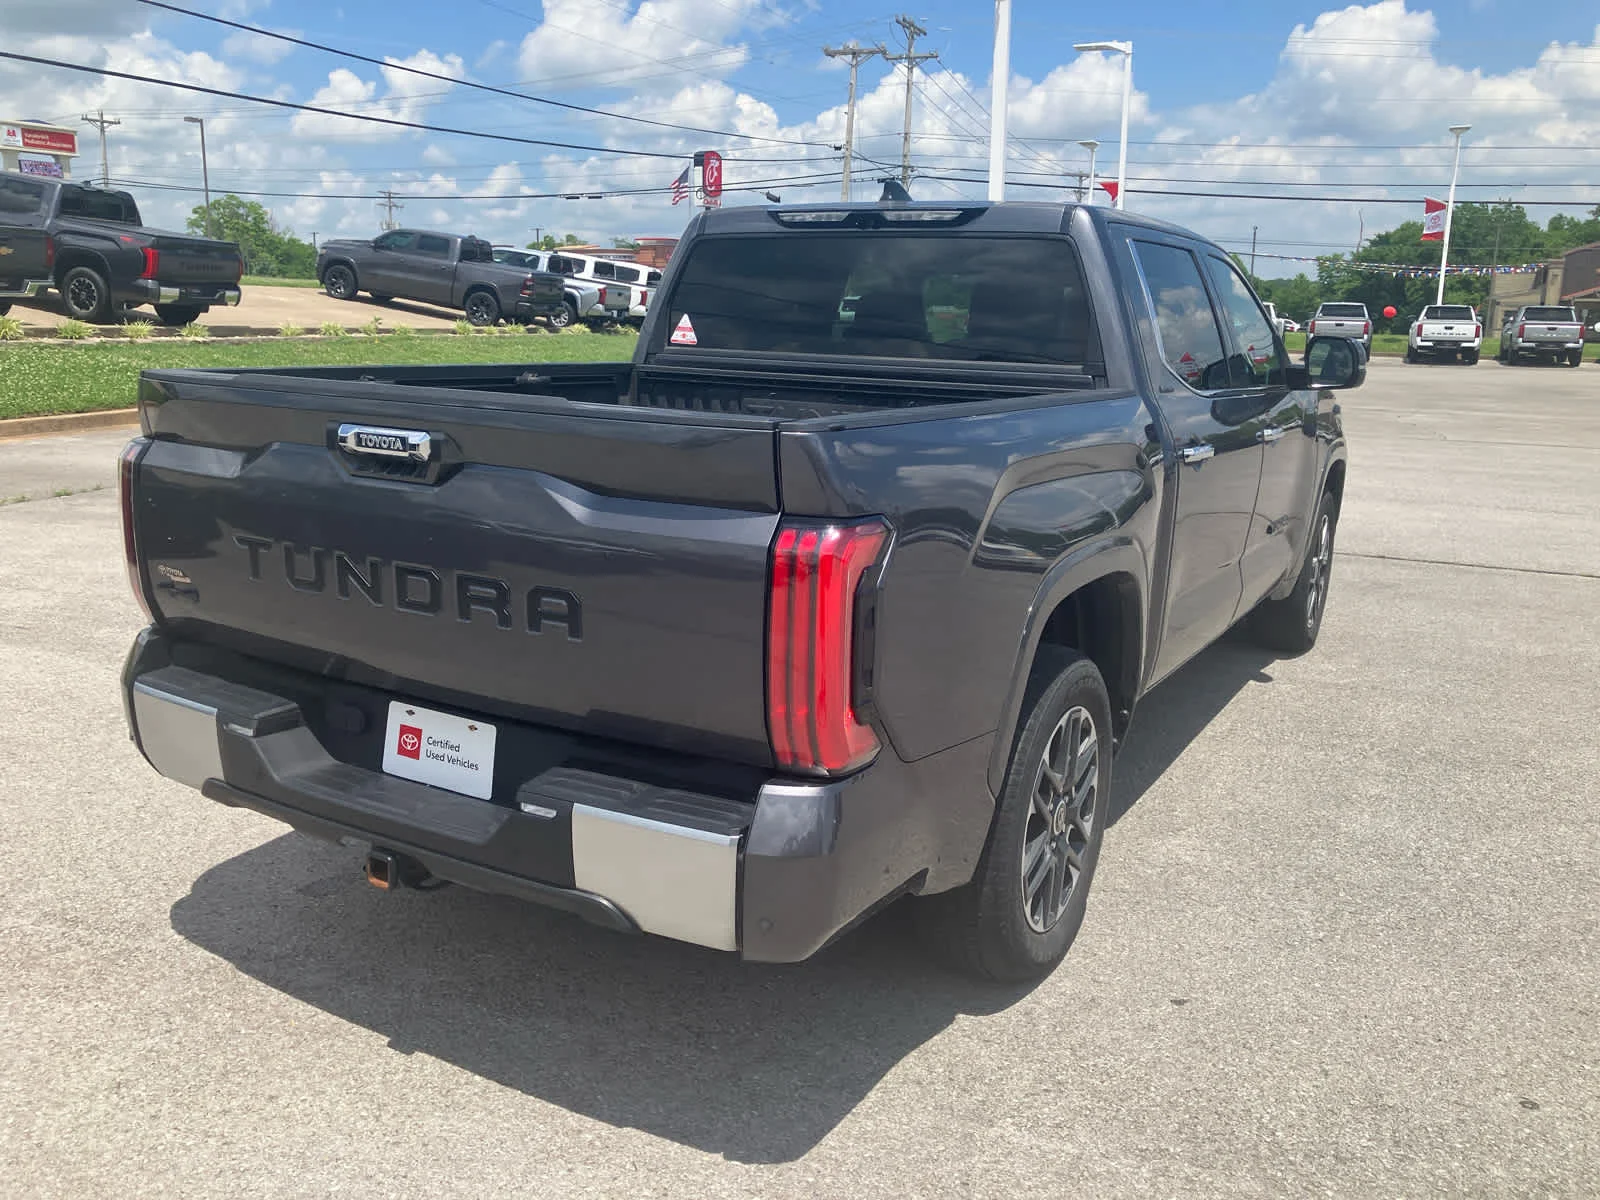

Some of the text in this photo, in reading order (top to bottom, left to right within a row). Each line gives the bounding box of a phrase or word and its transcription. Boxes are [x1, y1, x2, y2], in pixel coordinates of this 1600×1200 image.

[360, 433, 403, 450] TOYOTA
[232, 535, 583, 642] TUNDRA
[426, 736, 461, 753] Certified
[425, 749, 480, 771] Used Vehicles
